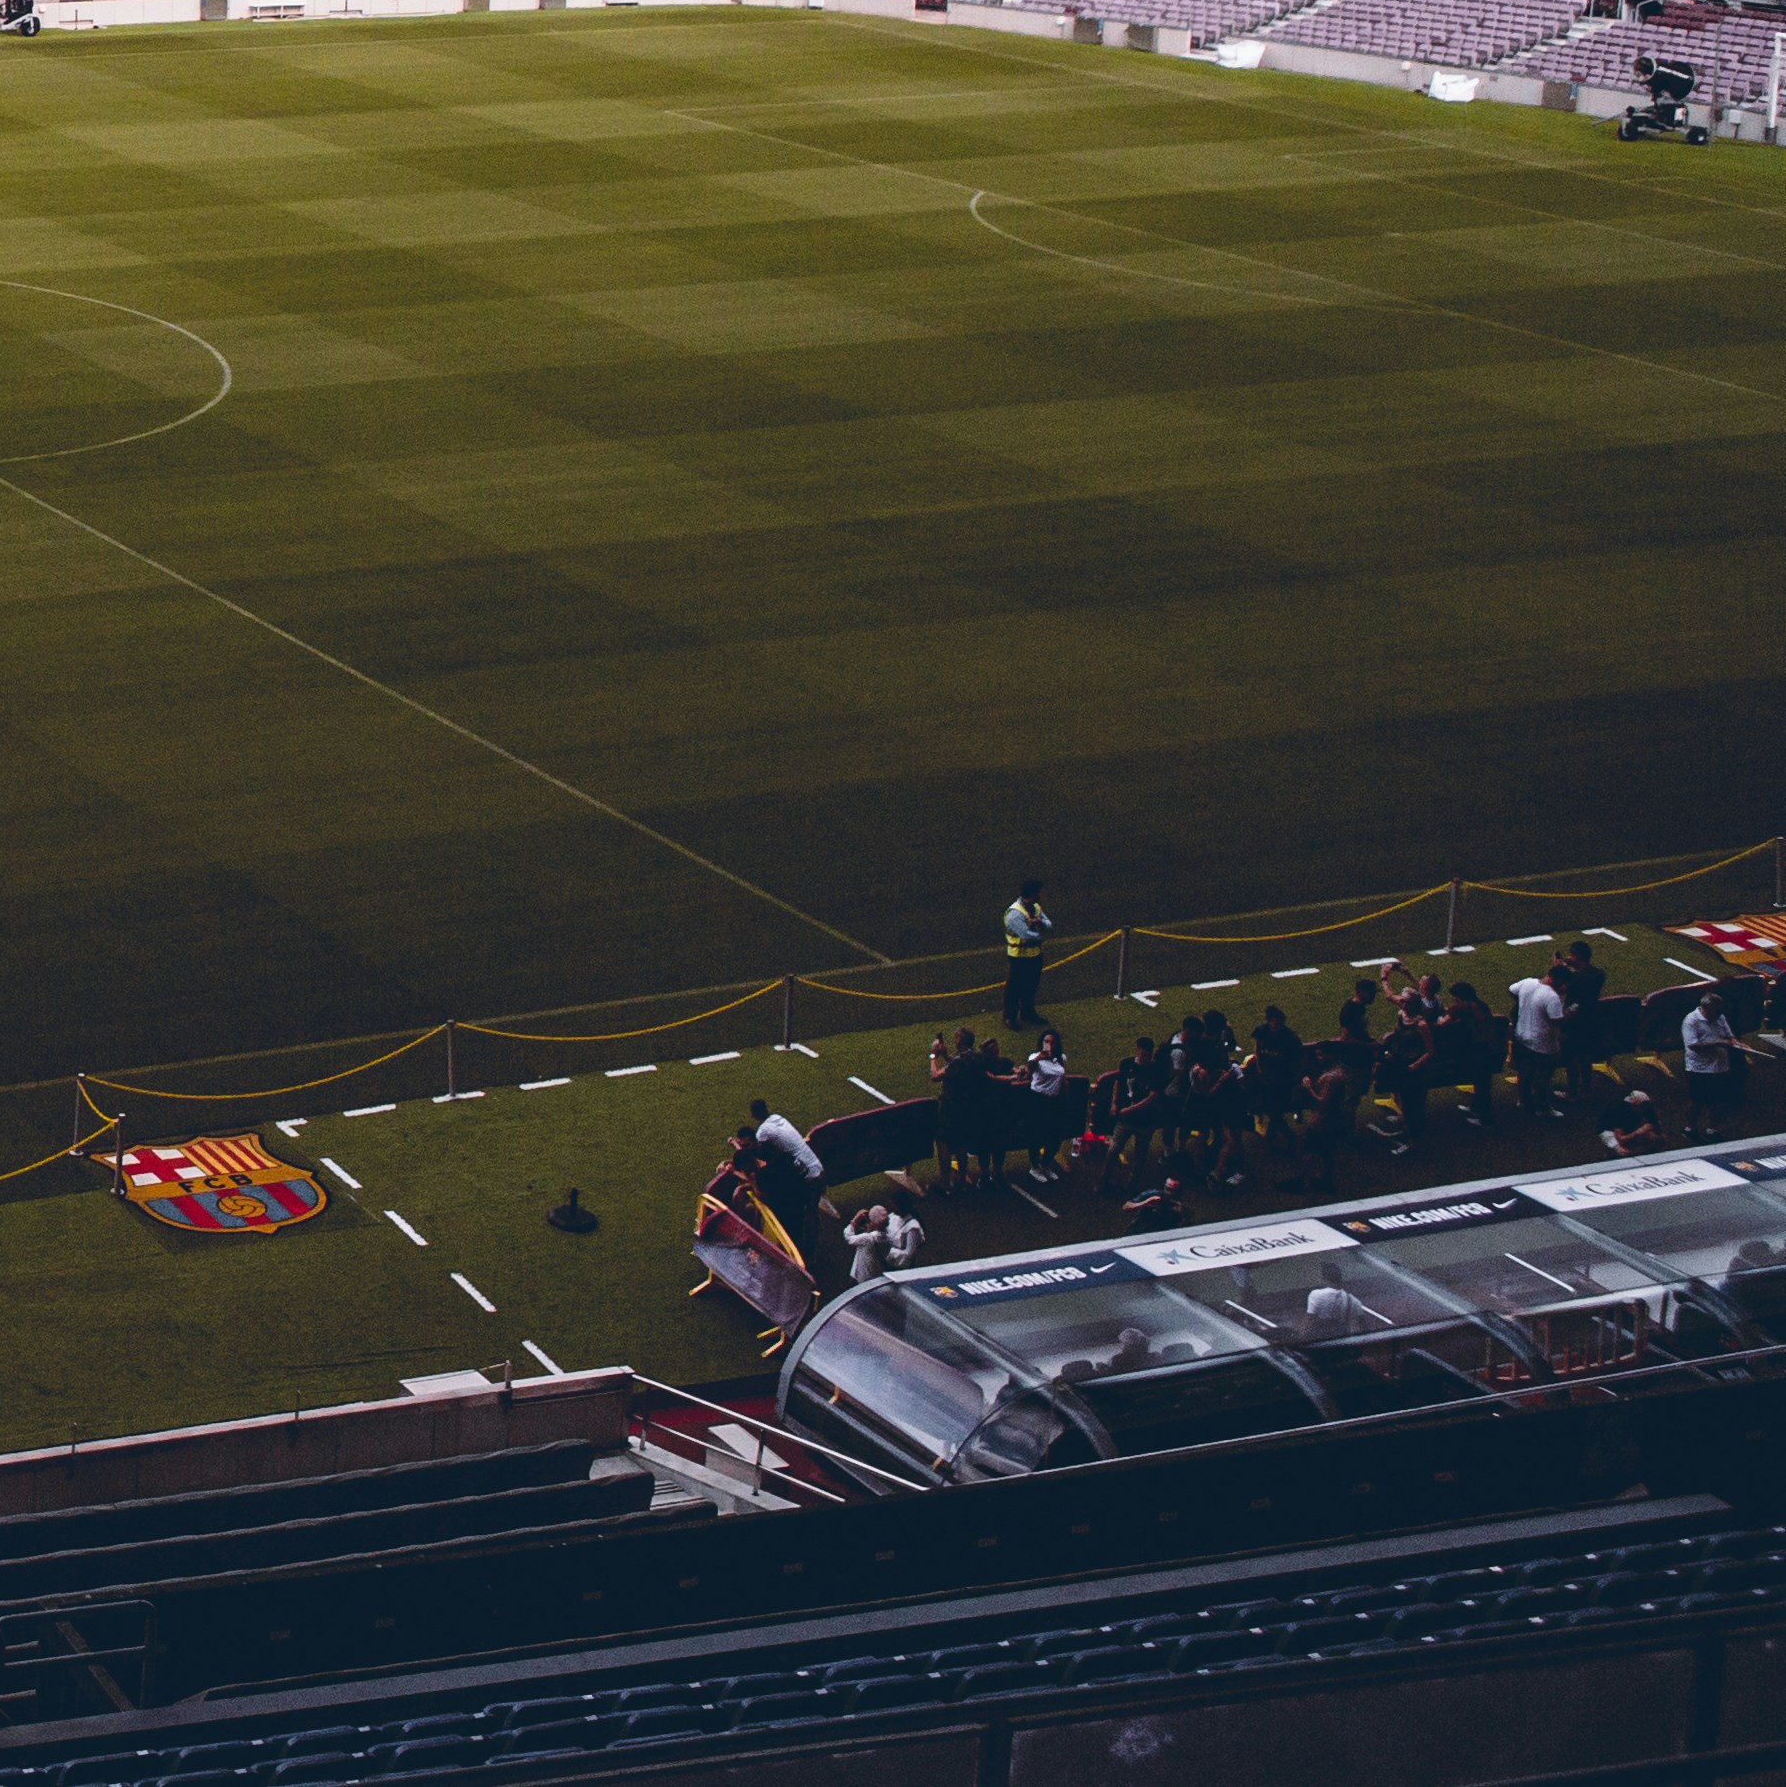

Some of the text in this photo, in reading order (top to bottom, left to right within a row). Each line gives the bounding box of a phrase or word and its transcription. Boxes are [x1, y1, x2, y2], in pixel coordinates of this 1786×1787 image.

[177, 1172, 254, 1194] FCB
[1585, 1169, 1705, 1196] CaixaBank
[1368, 1201, 1492, 1230] NIKE.COM/FCB
[1189, 1231, 1316, 1260] CaixaBank
[958, 1266, 1087, 1295] NIKE.COM/FCB
